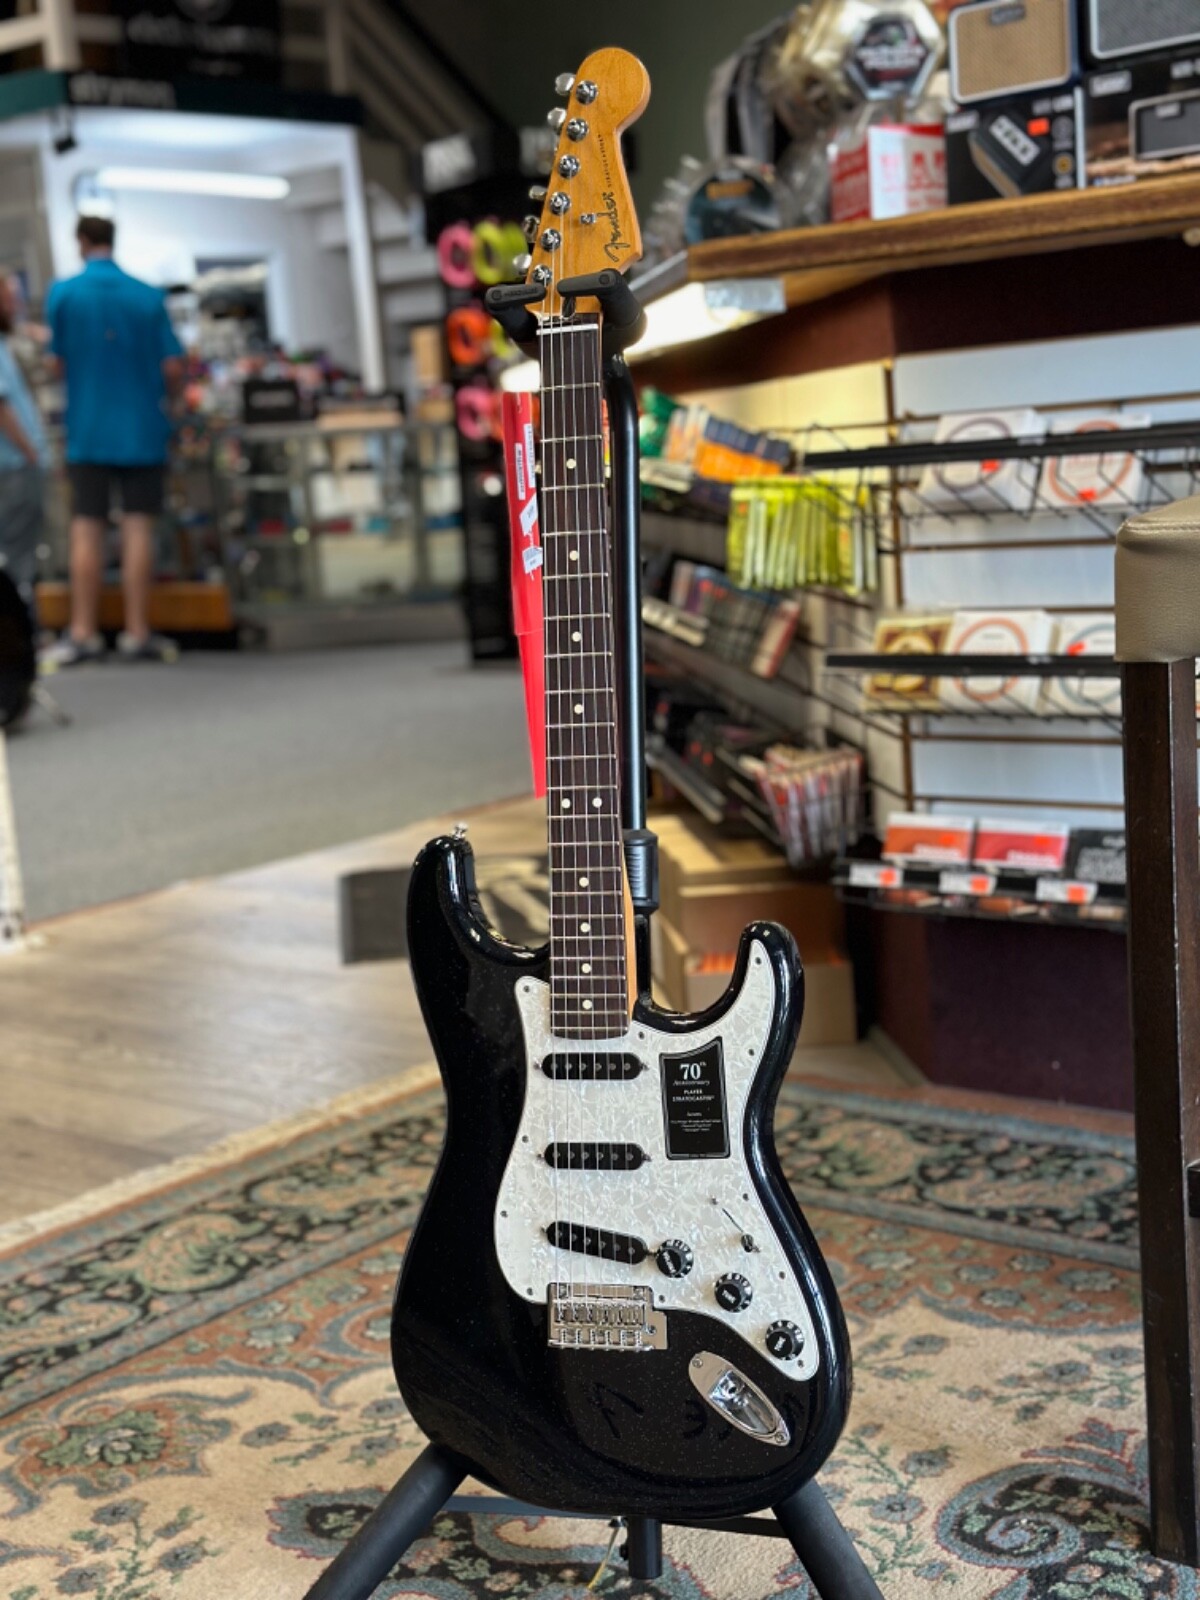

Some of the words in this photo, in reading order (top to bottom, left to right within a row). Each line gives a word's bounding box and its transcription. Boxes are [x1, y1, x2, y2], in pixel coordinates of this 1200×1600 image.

[596, 191, 631, 262] Fender
[722, 1290, 736, 1303] TONE
[774, 1336, 786, 1351] TONE
